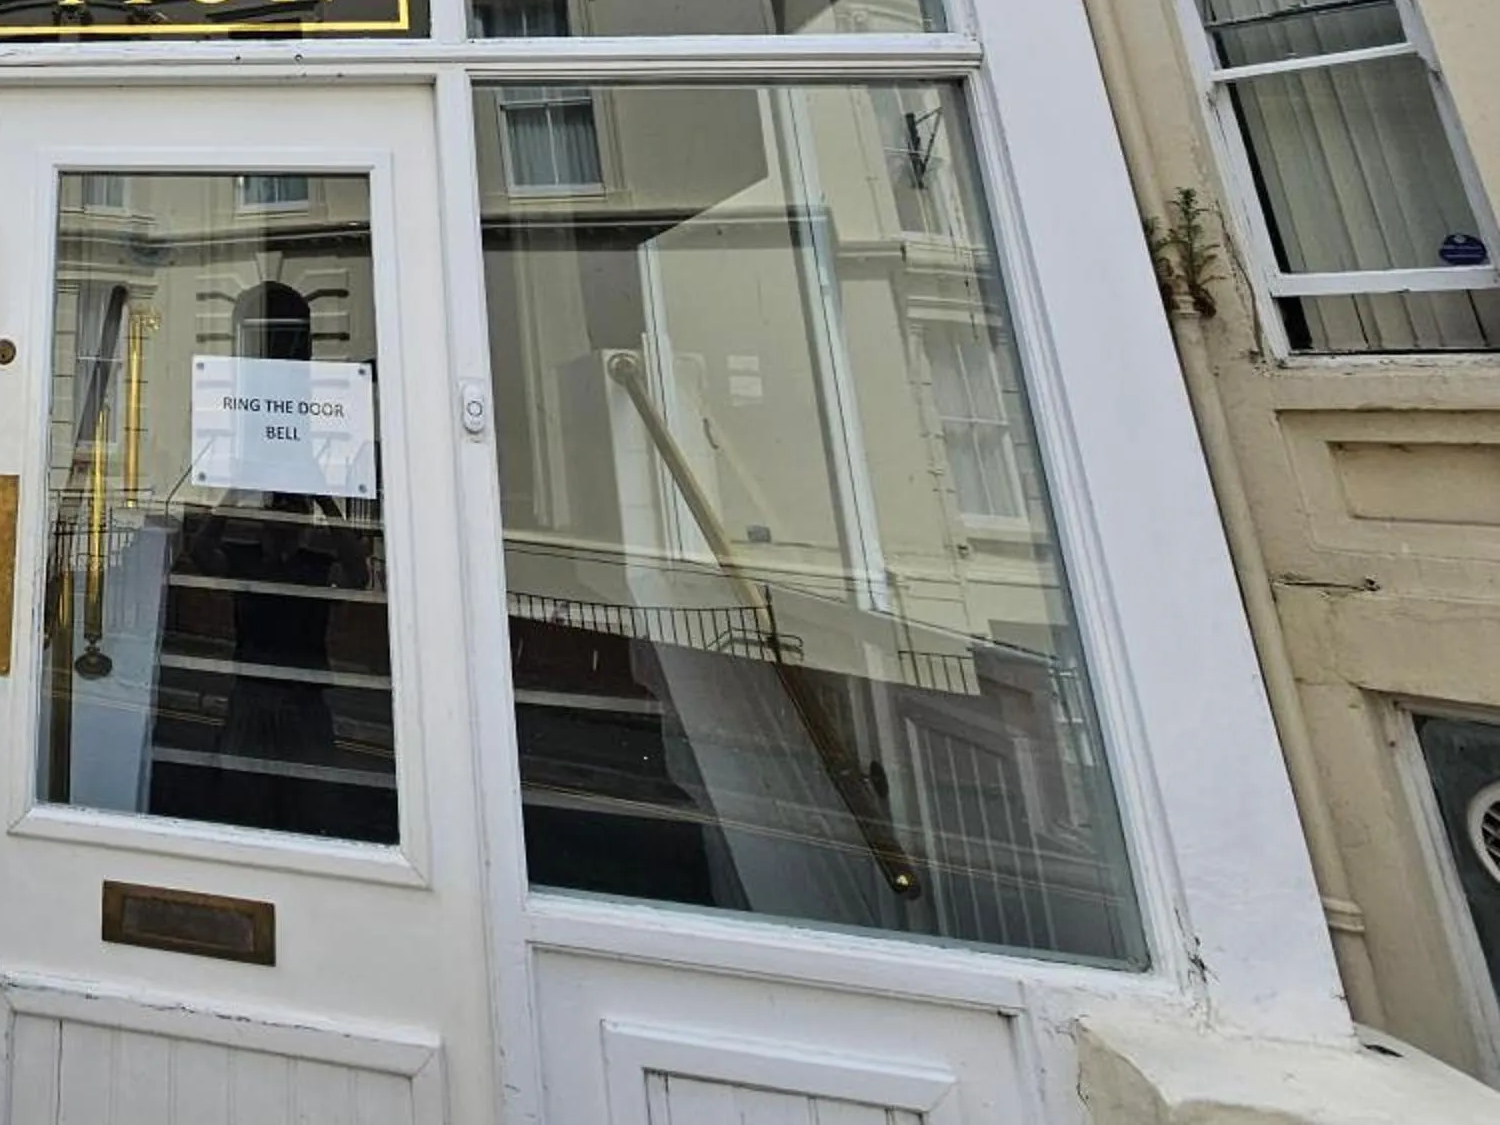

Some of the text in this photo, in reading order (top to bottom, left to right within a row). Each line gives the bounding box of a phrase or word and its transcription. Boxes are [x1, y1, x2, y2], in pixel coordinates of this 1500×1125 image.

[223, 397, 344, 418] RING THE DOOR
[266, 426, 300, 441] BELL
